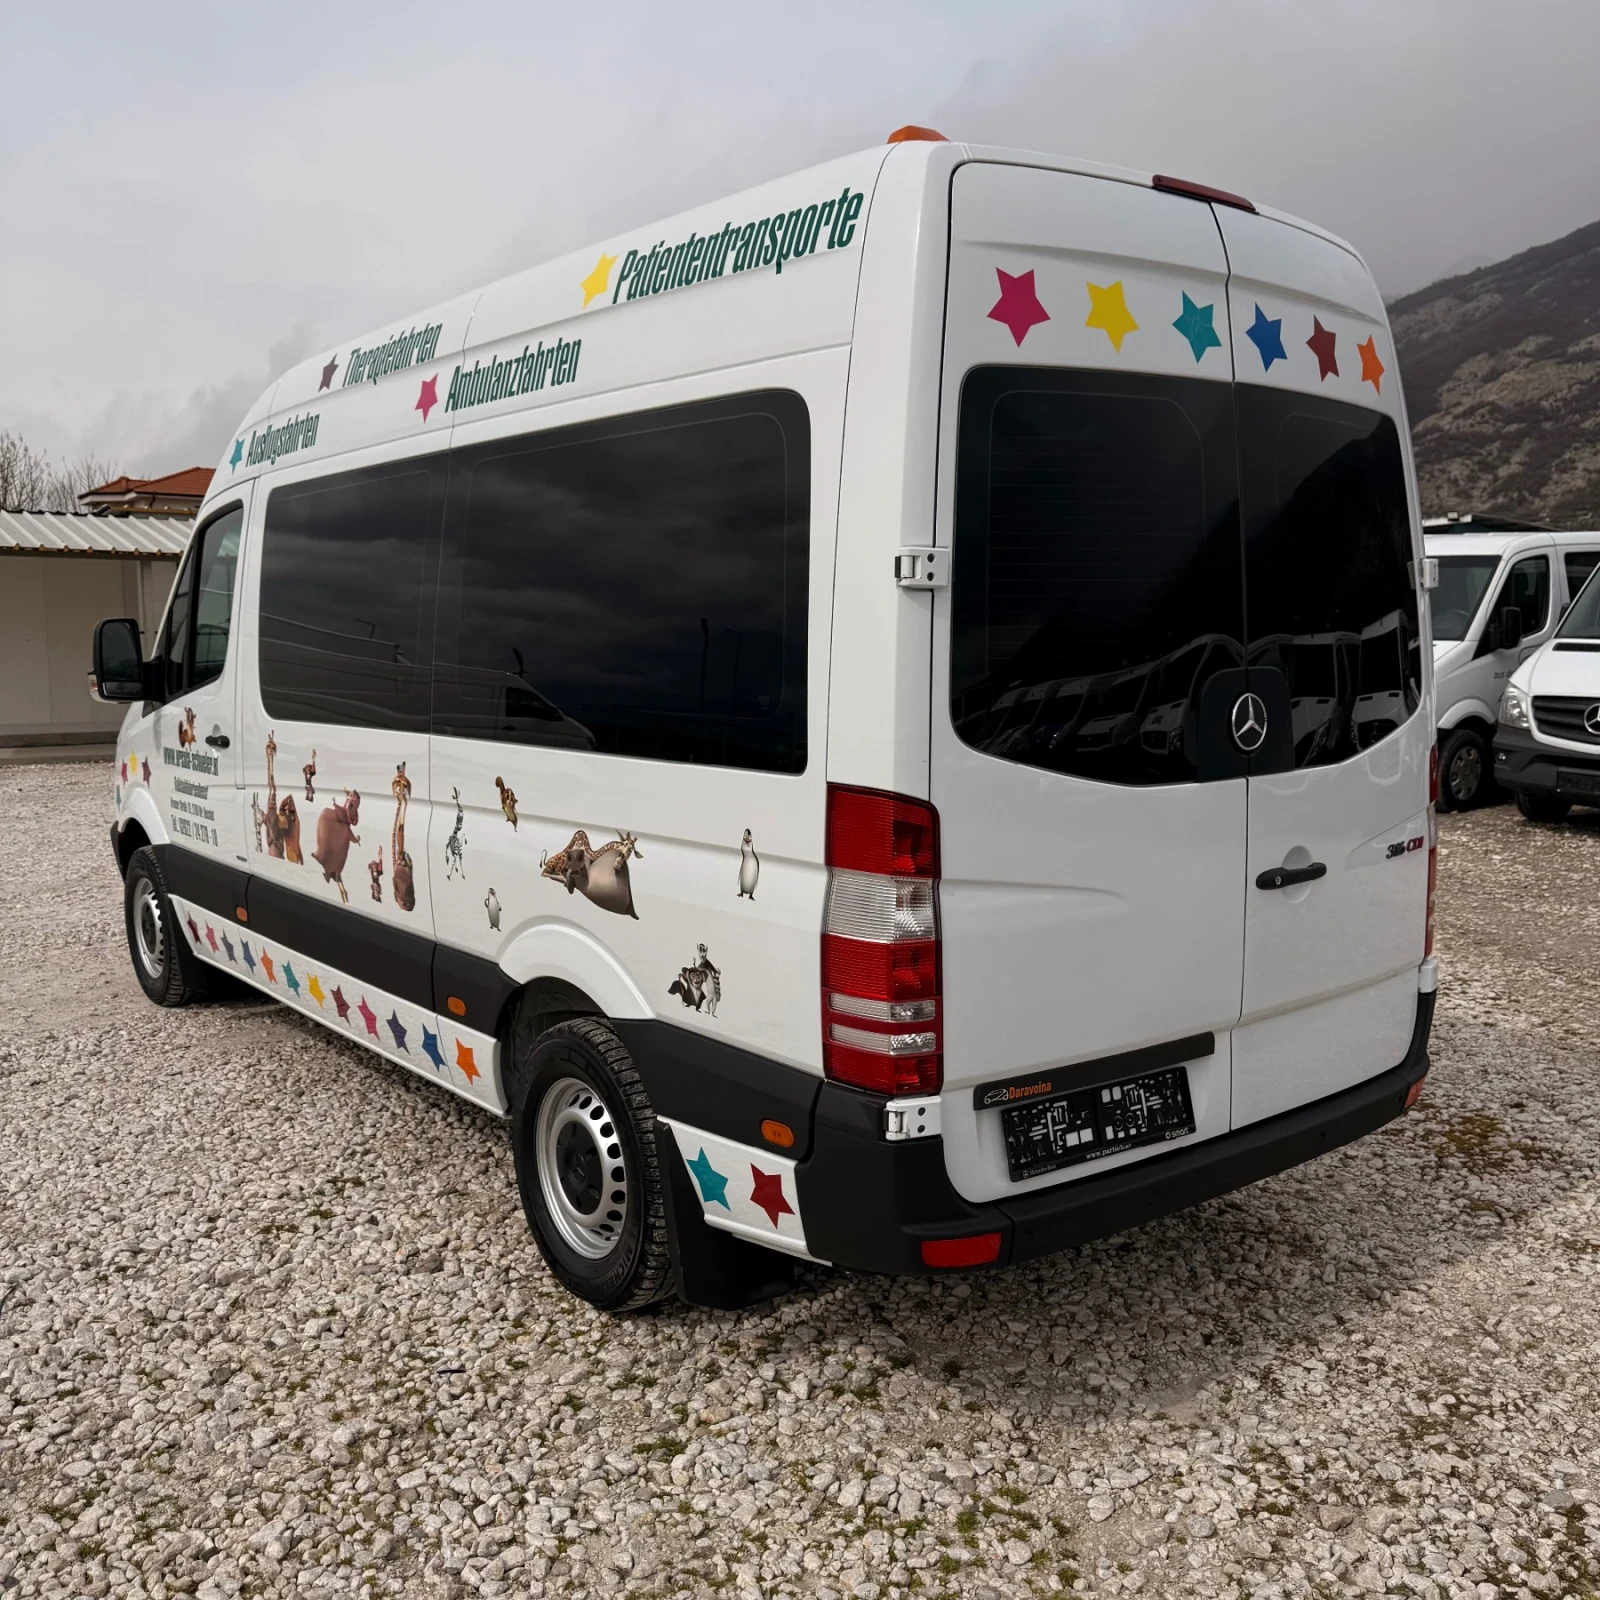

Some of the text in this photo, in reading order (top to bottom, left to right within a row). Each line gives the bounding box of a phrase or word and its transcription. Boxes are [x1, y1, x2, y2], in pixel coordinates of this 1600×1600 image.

[612, 187, 864, 305] Patiententransporte
[342, 322, 443, 388] Therapiefahrten
[444, 337, 582, 413] Ambulanzfahrten
[245, 413, 320, 467] Ausflugsfahrten
[1407, 836, 1424, 852] CDI
[1009, 1081, 1052, 1099] Daravoina
[1172, 1127, 1189, 1138] smart
